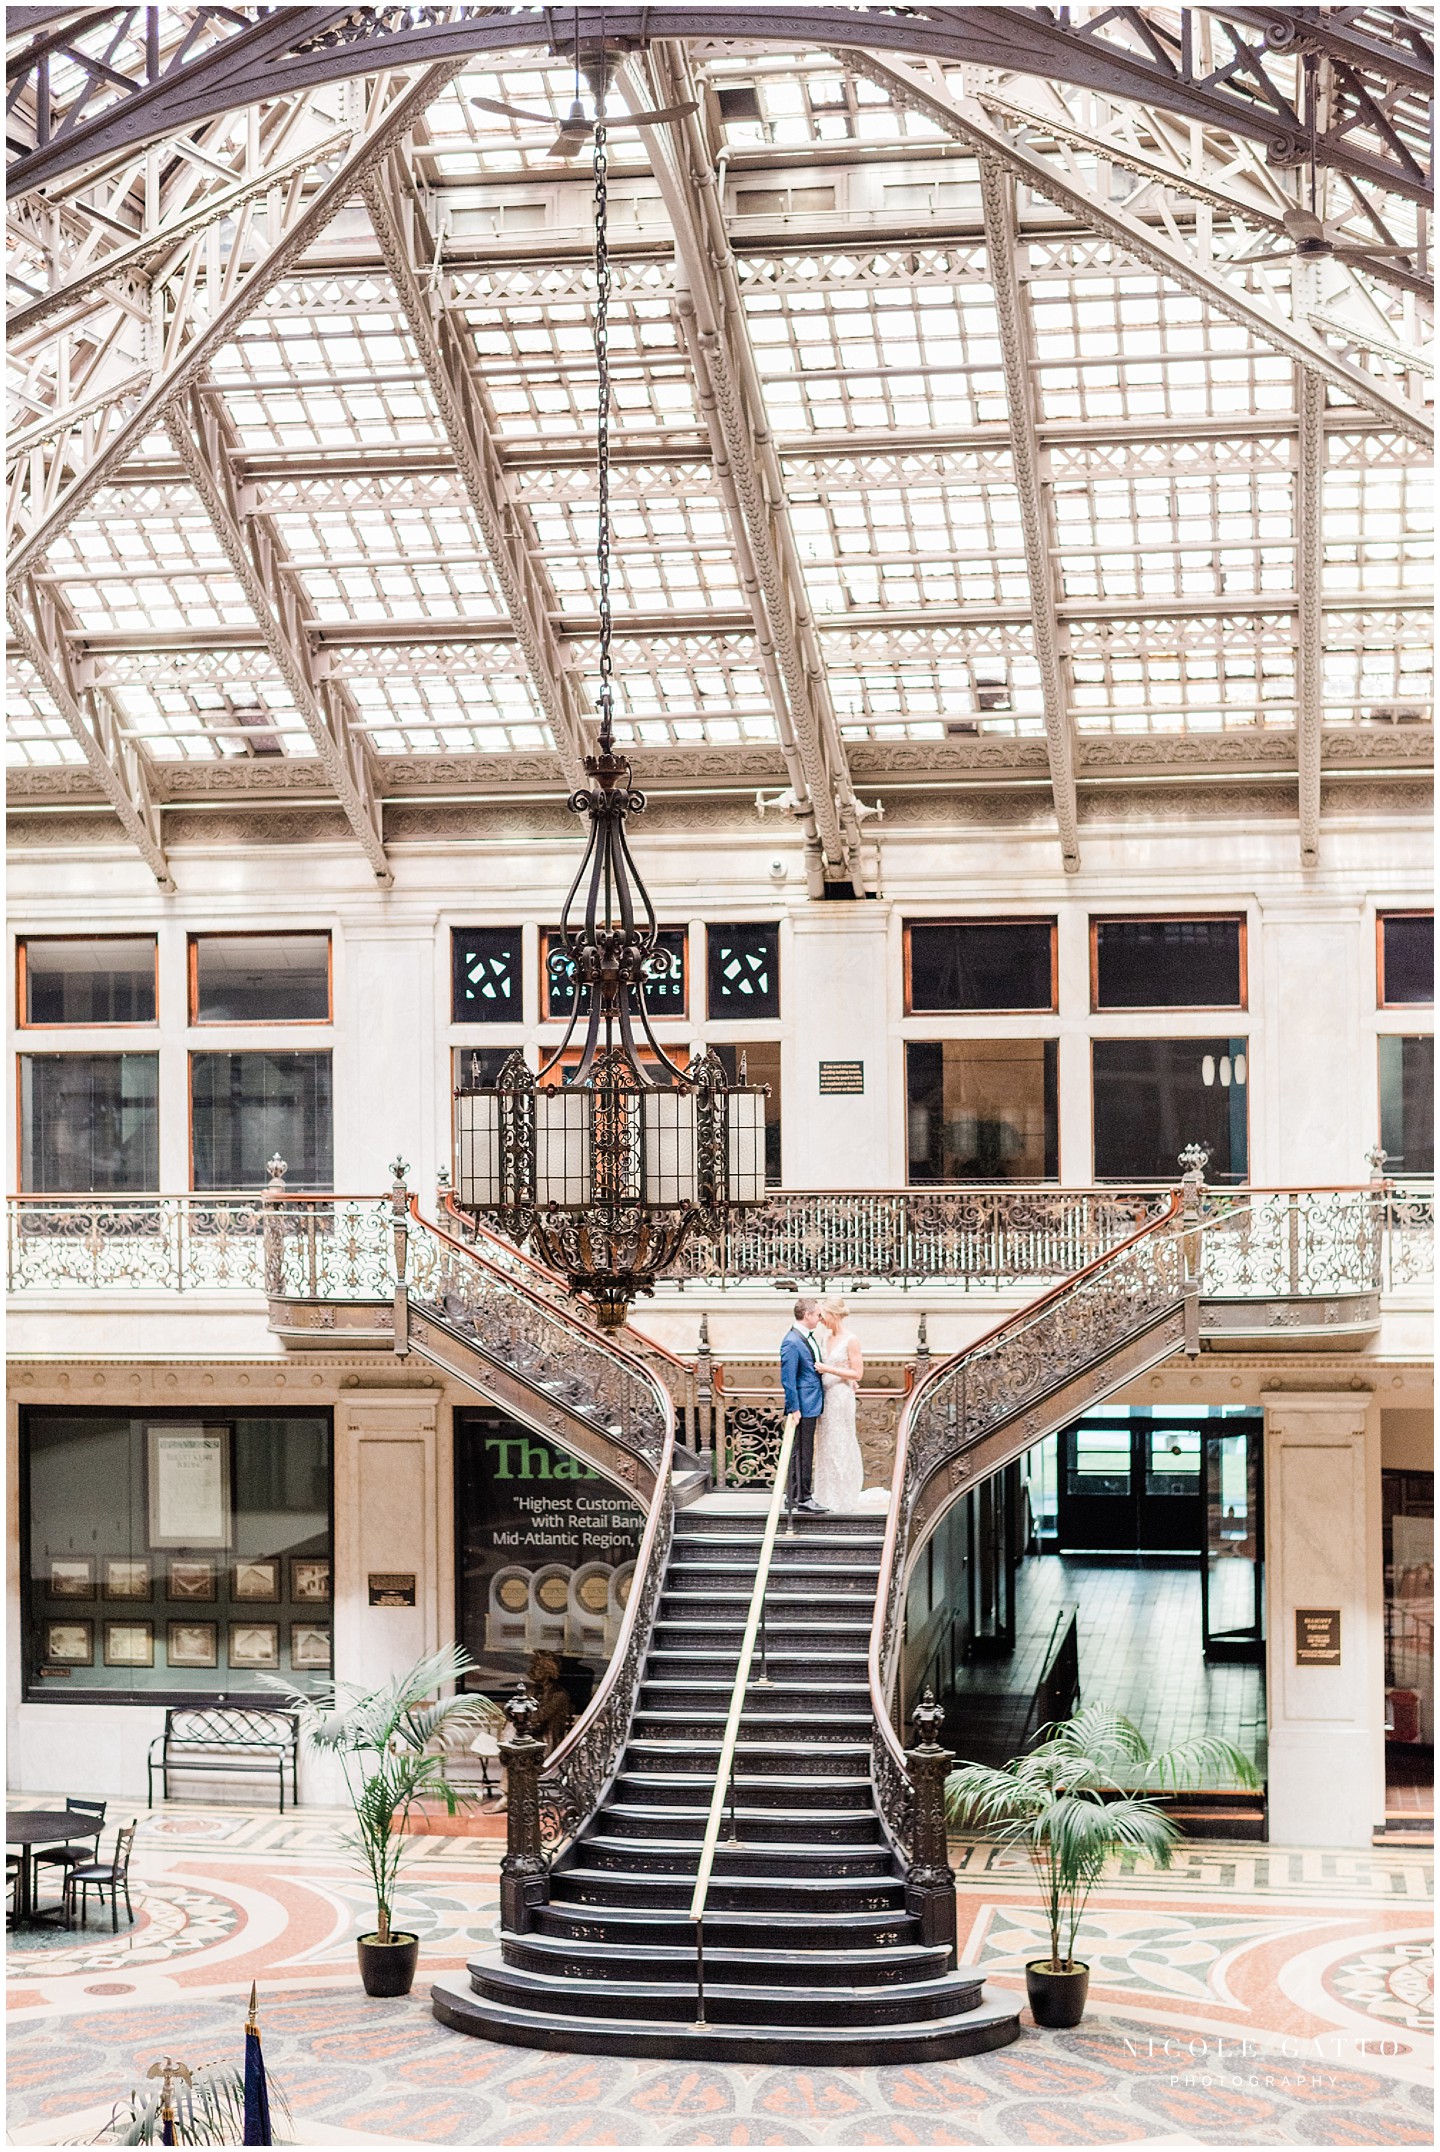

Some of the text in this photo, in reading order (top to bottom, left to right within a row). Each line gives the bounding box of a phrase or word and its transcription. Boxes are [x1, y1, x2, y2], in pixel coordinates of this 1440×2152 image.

[576, 1497, 639, 1511] Custome
[531, 1514, 564, 1528] with
[568, 1514, 608, 1528] Retail
[493, 1532, 579, 1545] Mid-Atlantic
[582, 1532, 634, 1548] Region,
